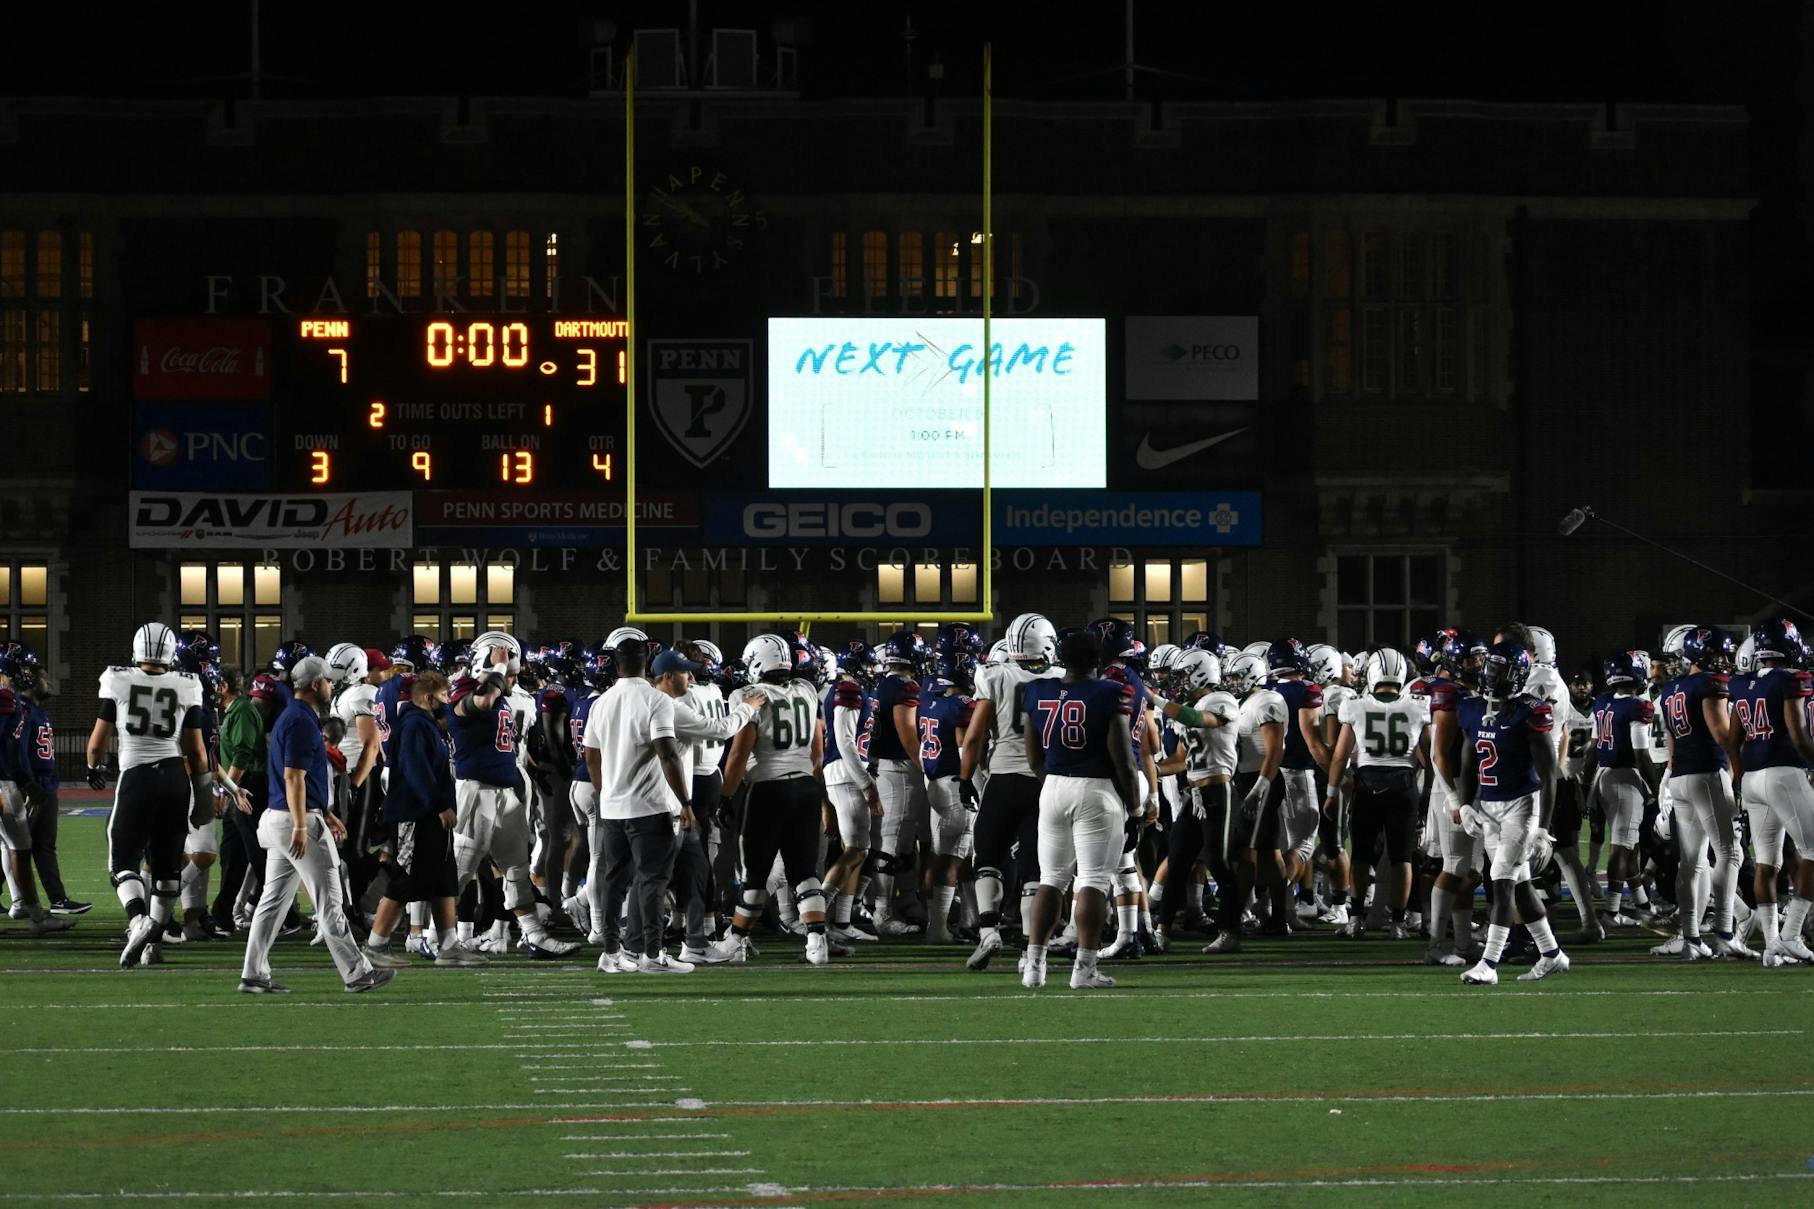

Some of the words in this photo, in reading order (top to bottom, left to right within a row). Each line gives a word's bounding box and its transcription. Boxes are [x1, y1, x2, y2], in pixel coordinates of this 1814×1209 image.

[203, 274, 624, 314] FRANKLIN
[809, 276, 1040, 314] FIELD
[301, 321, 349, 338] PENN
[427, 322, 528, 367] 0:00
[328, 348, 348, 384] 7
[576, 348, 627, 386] 31
[660, 349, 742, 369] PENN
[796, 343, 925, 376] NEXT
[947, 343, 1075, 385] GAME
[1192, 344, 1240, 360] PECO
[369, 402, 386, 427] 2
[395, 402, 434, 420] TIME
[439, 402, 483, 420] OUTS
[488, 402, 527, 420] LEFT
[544, 404, 551, 427] 1
[184, 432, 265, 461] PNC
[295, 434, 339, 450] DOWN
[388, 434, 407, 449] TO
[411, 434, 432, 449] GO
[481, 434, 515, 450] BALL
[519, 434, 540, 450] ON
[589, 435, 615, 450] QTR
[311, 451, 330, 484] 3
[412, 452, 431, 481] 9
[503, 451, 532, 483] 13
[592, 453, 612, 481] 4
[136, 498, 328, 527] DAVID
[321, 498, 409, 541] Auto
[443, 502, 496, 519] PENN
[501, 502, 575, 519] SPORTS
[579, 502, 675, 519] MEDICINE
[743, 503, 932, 538] GEICO
[1006, 503, 1203, 534] Independence
[262, 548, 438, 571] ROBERT
[461, 548, 577, 571] WOLF
[596, 548, 622, 572] &
[644, 547, 810, 572] FAMILY
[829, 547, 1134, 572] SCOREBOARD
[126, 684, 178, 739] 53
[771, 699, 810, 749] 60
[1037, 700, 1087, 750] 78
[1665, 691, 1693, 739] 19
[1736, 698, 1775, 742] 84
[1365, 712, 1409, 757] 56
[1477, 731, 1497, 740] PENN
[1597, 709, 1615, 750] 14
[1475, 739, 1499, 787] 2
